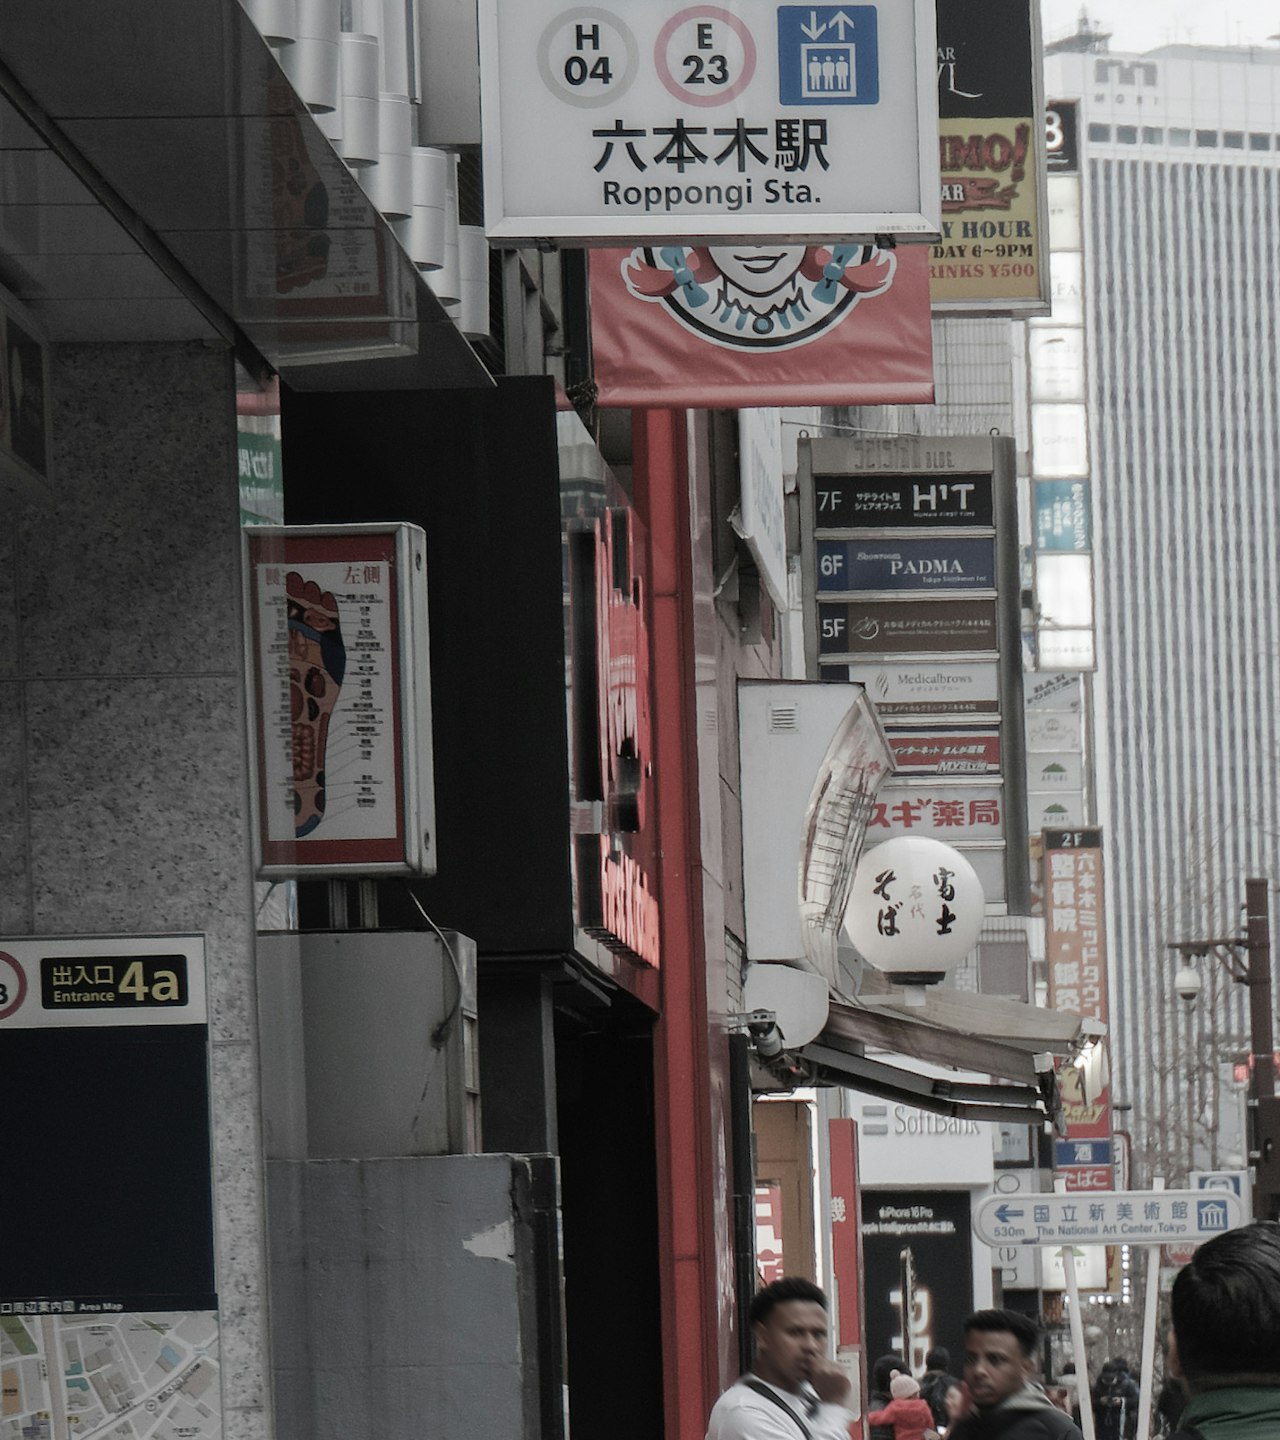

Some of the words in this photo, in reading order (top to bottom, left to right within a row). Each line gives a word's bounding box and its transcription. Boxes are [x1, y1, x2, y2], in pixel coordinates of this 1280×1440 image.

[576, 24, 600, 51] H
[697, 23, 714, 50] E
[564, 55, 613, 86] 04
[683, 54, 730, 84] 23
[592, 117, 830, 174] 六本木駅
[602, 178, 752, 212] Roppongi
[764, 178, 822, 204] Sta.
[962, 220, 1033, 239] HOUR
[929, 244, 968, 259] DAY
[817, 490, 842, 512] 7F
[821, 555, 843, 576] 6F
[891, 559, 964, 575] PADMA
[822, 618, 845, 638] 5F
[898, 673, 973, 685] Medicalbrows
[867, 798, 1000, 828] スギ薬局
[1062, 832, 1083, 848] 2F
[873, 868, 904, 937] そば
[907, 885, 926, 919] 名代
[933, 867, 956, 936] 富士
[53, 965, 114, 986] 出入口
[118, 961, 180, 1001] 4a
[53, 991, 115, 1002] Entrance
[894, 1104, 981, 1137] SoftBank
[1062, 1171, 1108, 1188] たばこ
[1034, 1201, 1189, 1223] 国立新美術館
[994, 1227, 1025, 1237] 530m
[1037, 1225, 1055, 1236] The
[1058, 1224, 1098, 1235] National
[1102, 1223, 1117, 1234] Art
[1158, 1222, 1187, 1234] Tokyo
[79, 1302, 102, 1312] Area
[103, 1302, 123, 1313] Map
